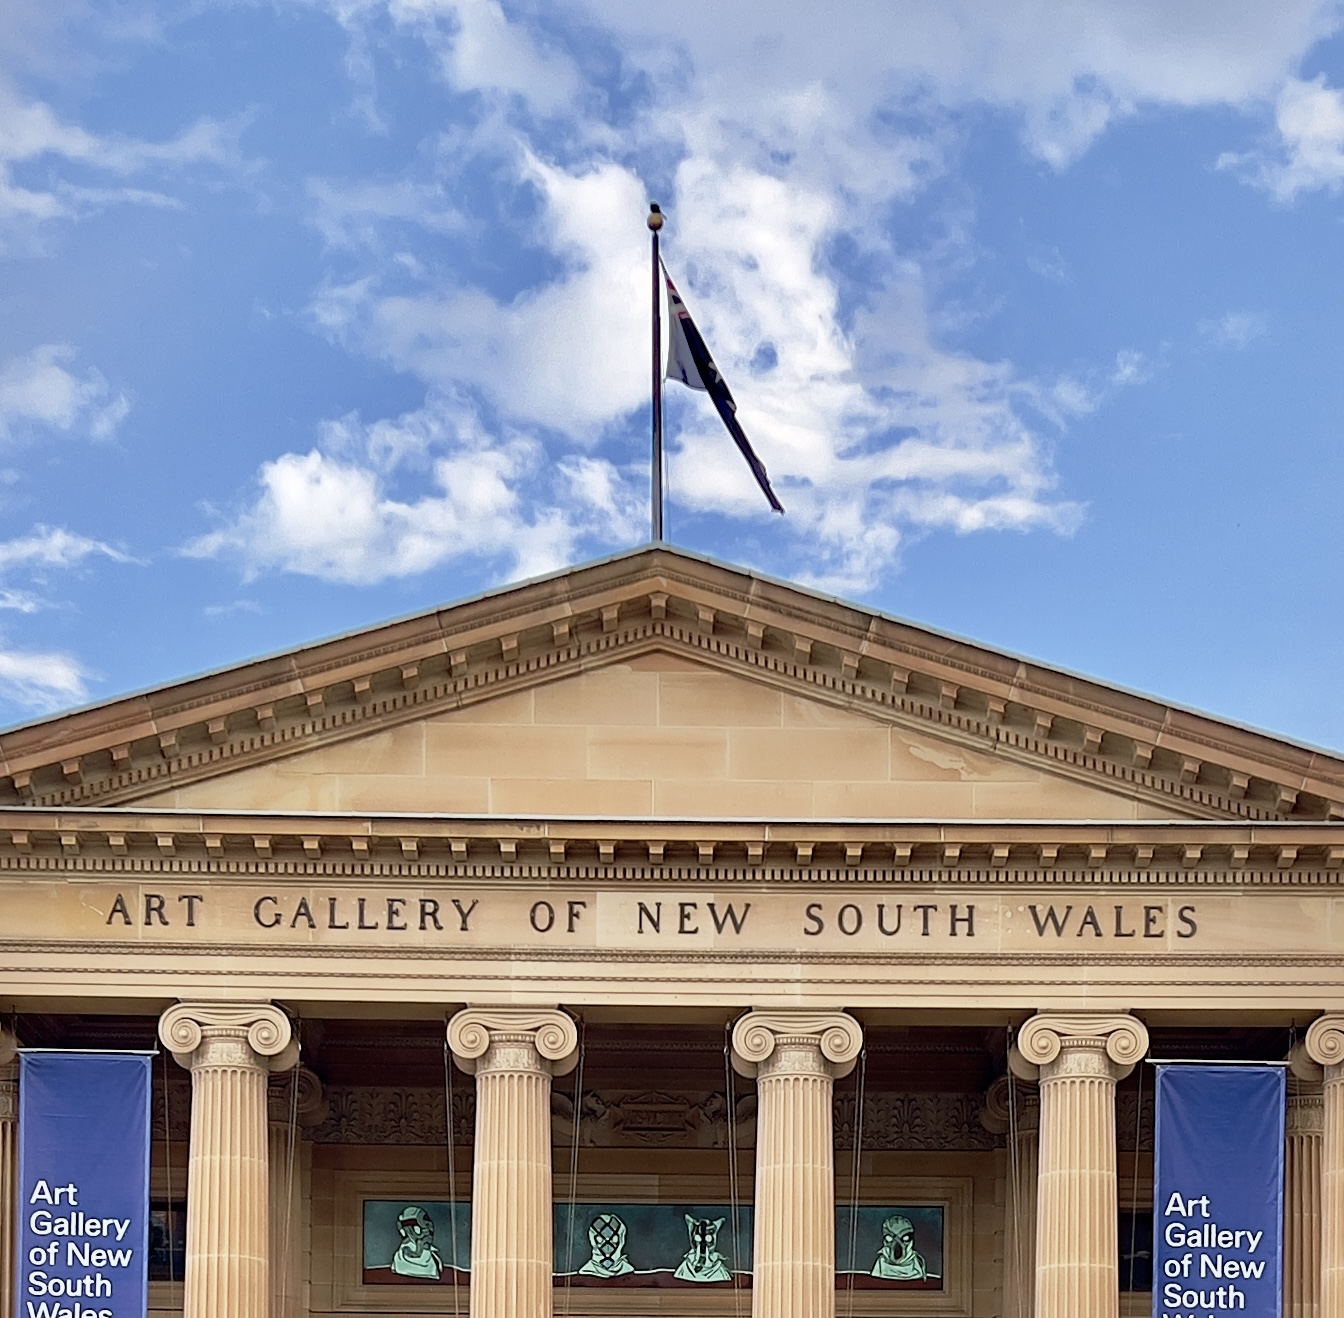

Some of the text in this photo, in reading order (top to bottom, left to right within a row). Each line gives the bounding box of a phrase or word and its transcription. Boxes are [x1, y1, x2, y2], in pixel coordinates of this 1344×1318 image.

[106, 893, 1198, 938] ART GALLERY OF NEW SOUTH WALES
[29, 1179, 78, 1206] Art
[1164, 1192, 1211, 1218] Art
[29, 1210, 131, 1242] Gallery
[1164, 1223, 1263, 1254] Gallery
[28, 1241, 133, 1268] of New
[1163, 1253, 1266, 1280] of New
[27, 1271, 112, 1298] South
[1163, 1283, 1246, 1310] South
